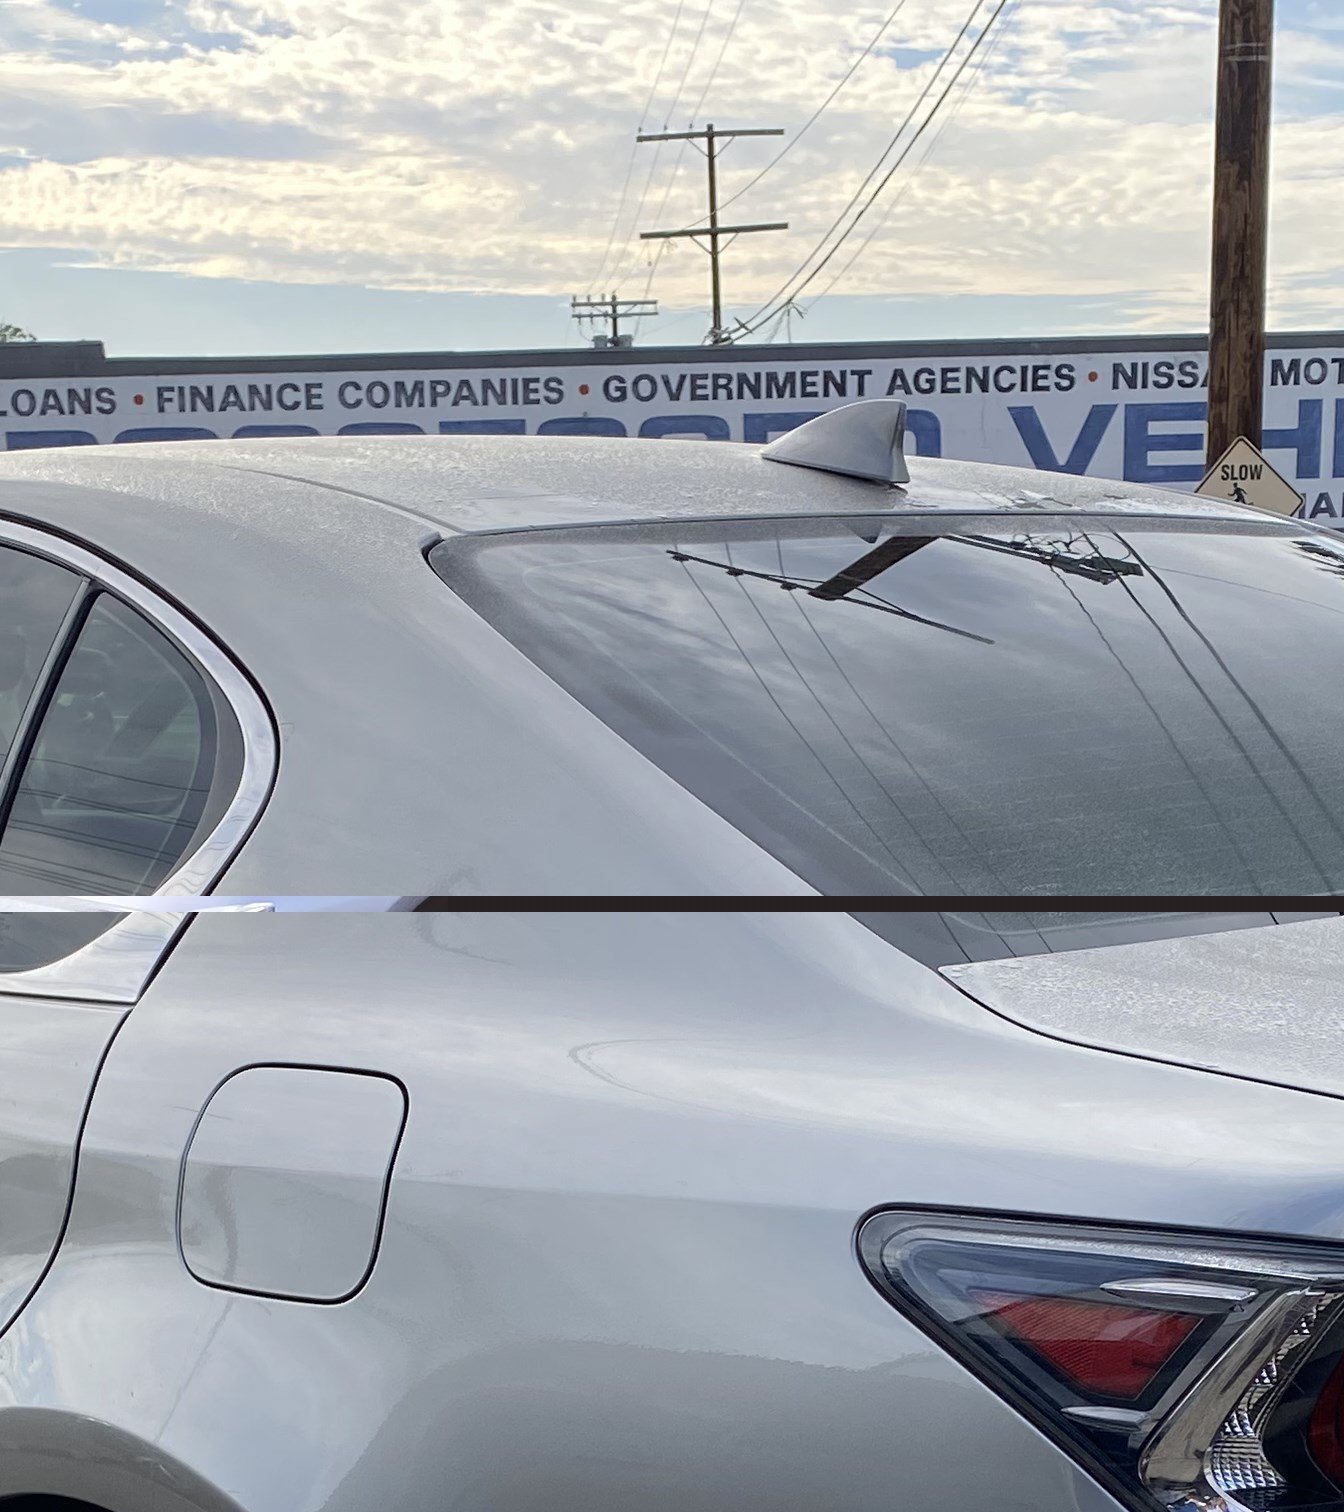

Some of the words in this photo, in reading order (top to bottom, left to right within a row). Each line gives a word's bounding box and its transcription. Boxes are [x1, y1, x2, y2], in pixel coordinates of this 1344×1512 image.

[602, 368, 872, 403] GOVERNMENT
[885, 363, 1076, 396] AGENCIES
[1111, 360, 1209, 391] NISS
[156, 382, 324, 414] FINANCE
[337, 376, 565, 410] COMPANIES
[1220, 463, 1264, 482] SLOW
